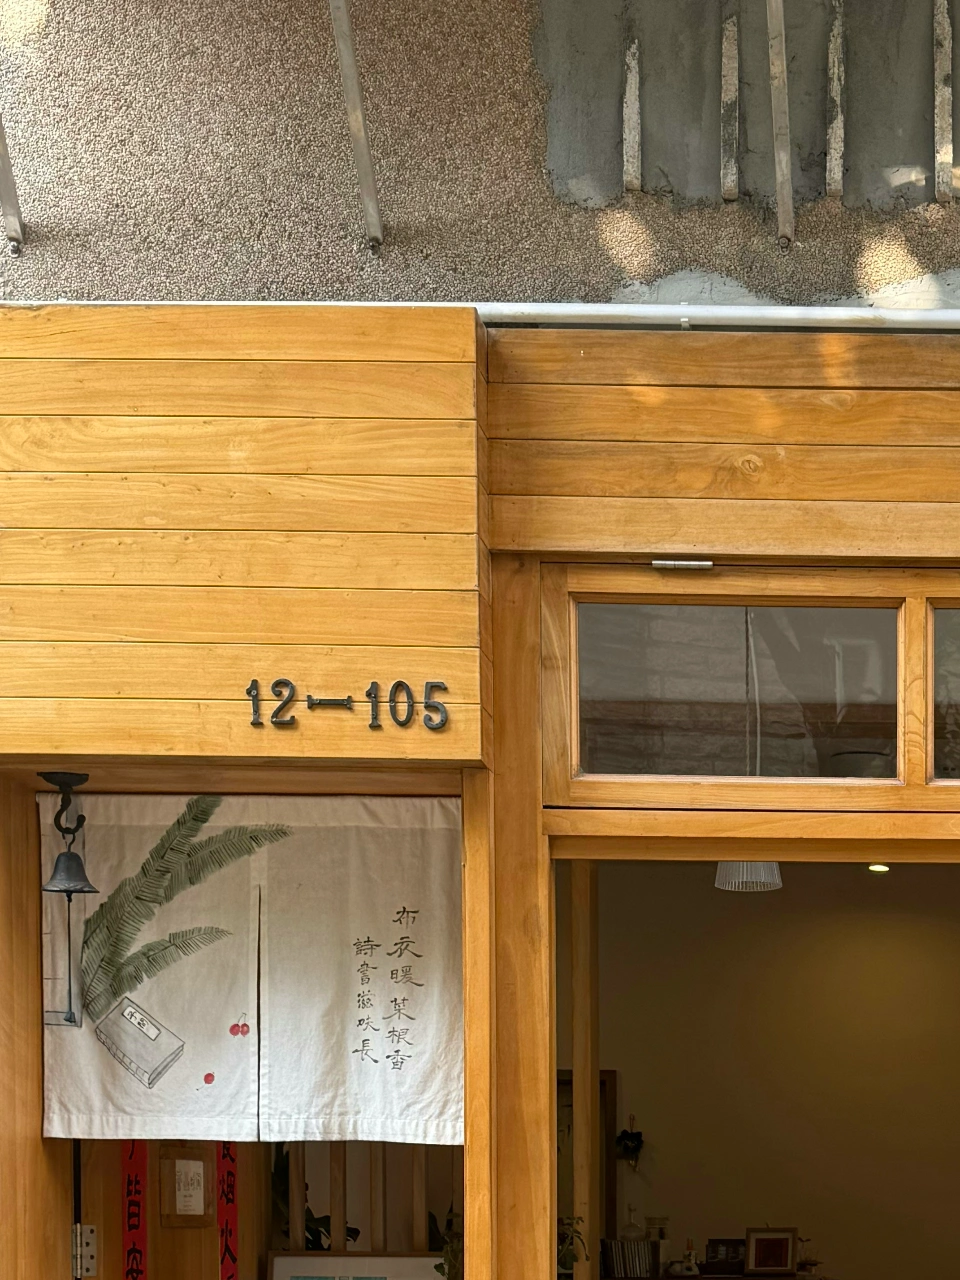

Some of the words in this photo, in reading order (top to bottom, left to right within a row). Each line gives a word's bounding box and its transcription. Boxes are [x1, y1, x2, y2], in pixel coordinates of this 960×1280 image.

[246, 678, 448, 730] 12-105
[382, 906, 425, 1070] 布衣暖菜根香
